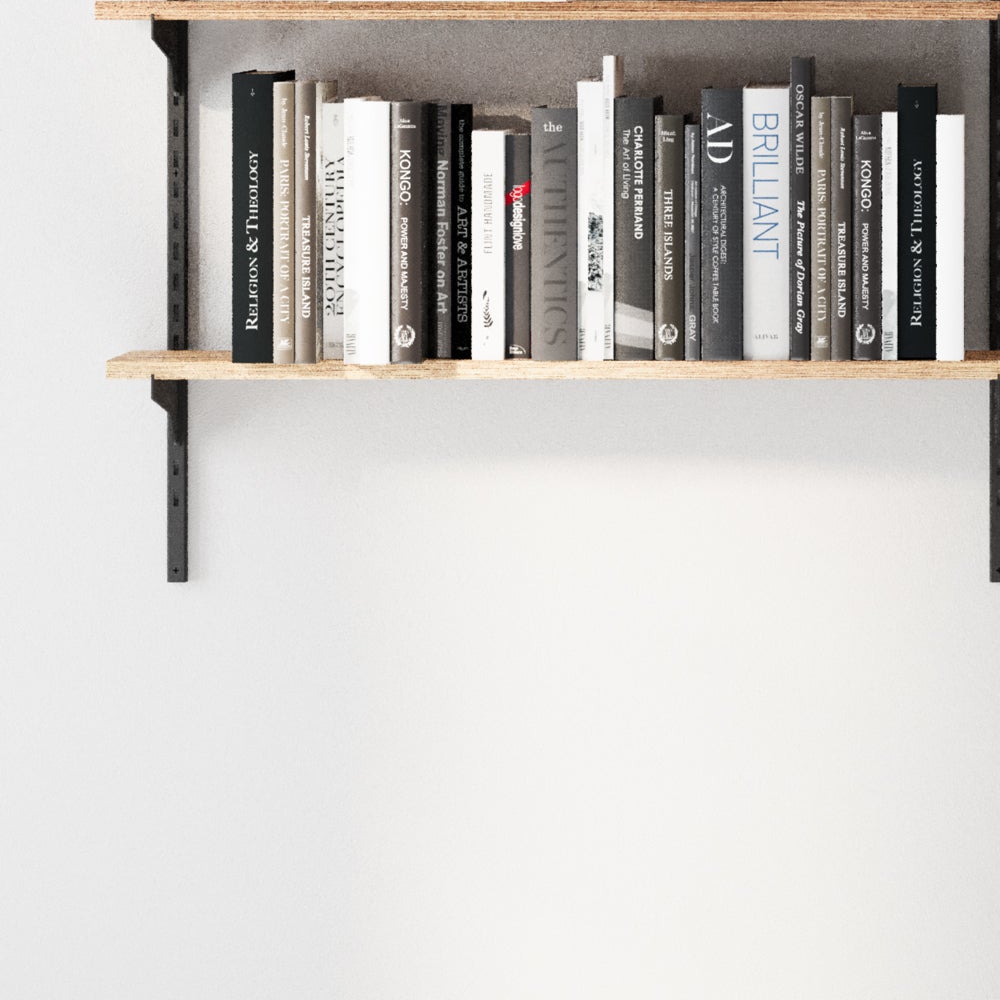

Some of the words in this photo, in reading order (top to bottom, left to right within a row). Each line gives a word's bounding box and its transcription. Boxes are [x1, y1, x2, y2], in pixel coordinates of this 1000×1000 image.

[796, 84, 804, 128] OSCAR
[543, 122, 562, 132] the
[622, 129, 631, 144] The
[706, 113, 733, 164] AD
[457, 134, 465, 169] complete
[622, 147, 631, 160] Art
[622, 162, 631, 172] of
[634, 126, 643, 185] CHARLOTTE
[796, 132, 804, 174] WILDE
[279, 160, 290, 196] PARIS:
[400, 150, 410, 206] KONGO:
[436, 160, 448, 216] Norman
[457, 171, 465, 192] guide
[620, 174, 631, 199] Living
[752, 112, 779, 260] BRILLIANT
[816, 170, 826, 204] PARIS:
[860, 160, 872, 212] KONGO:
[325, 158, 335, 250] CENTURY
[484, 173, 493, 224] HANDMADE
[510, 184, 526, 250] logodesignlove
[634, 188, 643, 239] PERRIAND
[664, 189, 673, 228] THREE
[796, 200, 805, 218] The
[279, 201, 290, 262] PORTRAIT
[336, 157, 344, 315] ENCYCLOPEDIA
[400, 217, 408, 249] POWER
[457, 206, 468, 237] ART
[796, 222, 805, 256] Picture
[816, 208, 826, 264] PORTRAIT
[301, 216, 310, 273] TREASURE
[436, 222, 448, 266] Foster
[457, 241, 468, 255] &
[484, 229, 493, 253] FLINT
[543, 141, 567, 346] AUTHENTICS
[664, 232, 673, 280] ISLANDS
[838, 222, 846, 276] TREASURE
[279, 266, 290, 281] OF
[400, 251, 408, 269] AND
[436, 270, 446, 287] on
[794, 259, 805, 270] of
[816, 268, 826, 283] OF
[301, 277, 310, 318] ISLAND
[325, 259, 335, 316] 20TH
[400, 271, 408, 310] MAJESTY
[436, 292, 448, 314] Art
[457, 258, 468, 322] ARTISTS
[796, 272, 805, 306] Dorian
[838, 279, 846, 318] ISLAND
[279, 296, 290, 324] CITY
[688, 314, 696, 341] GRAY
[794, 310, 805, 334] Gray
[816, 296, 826, 322] CITY
